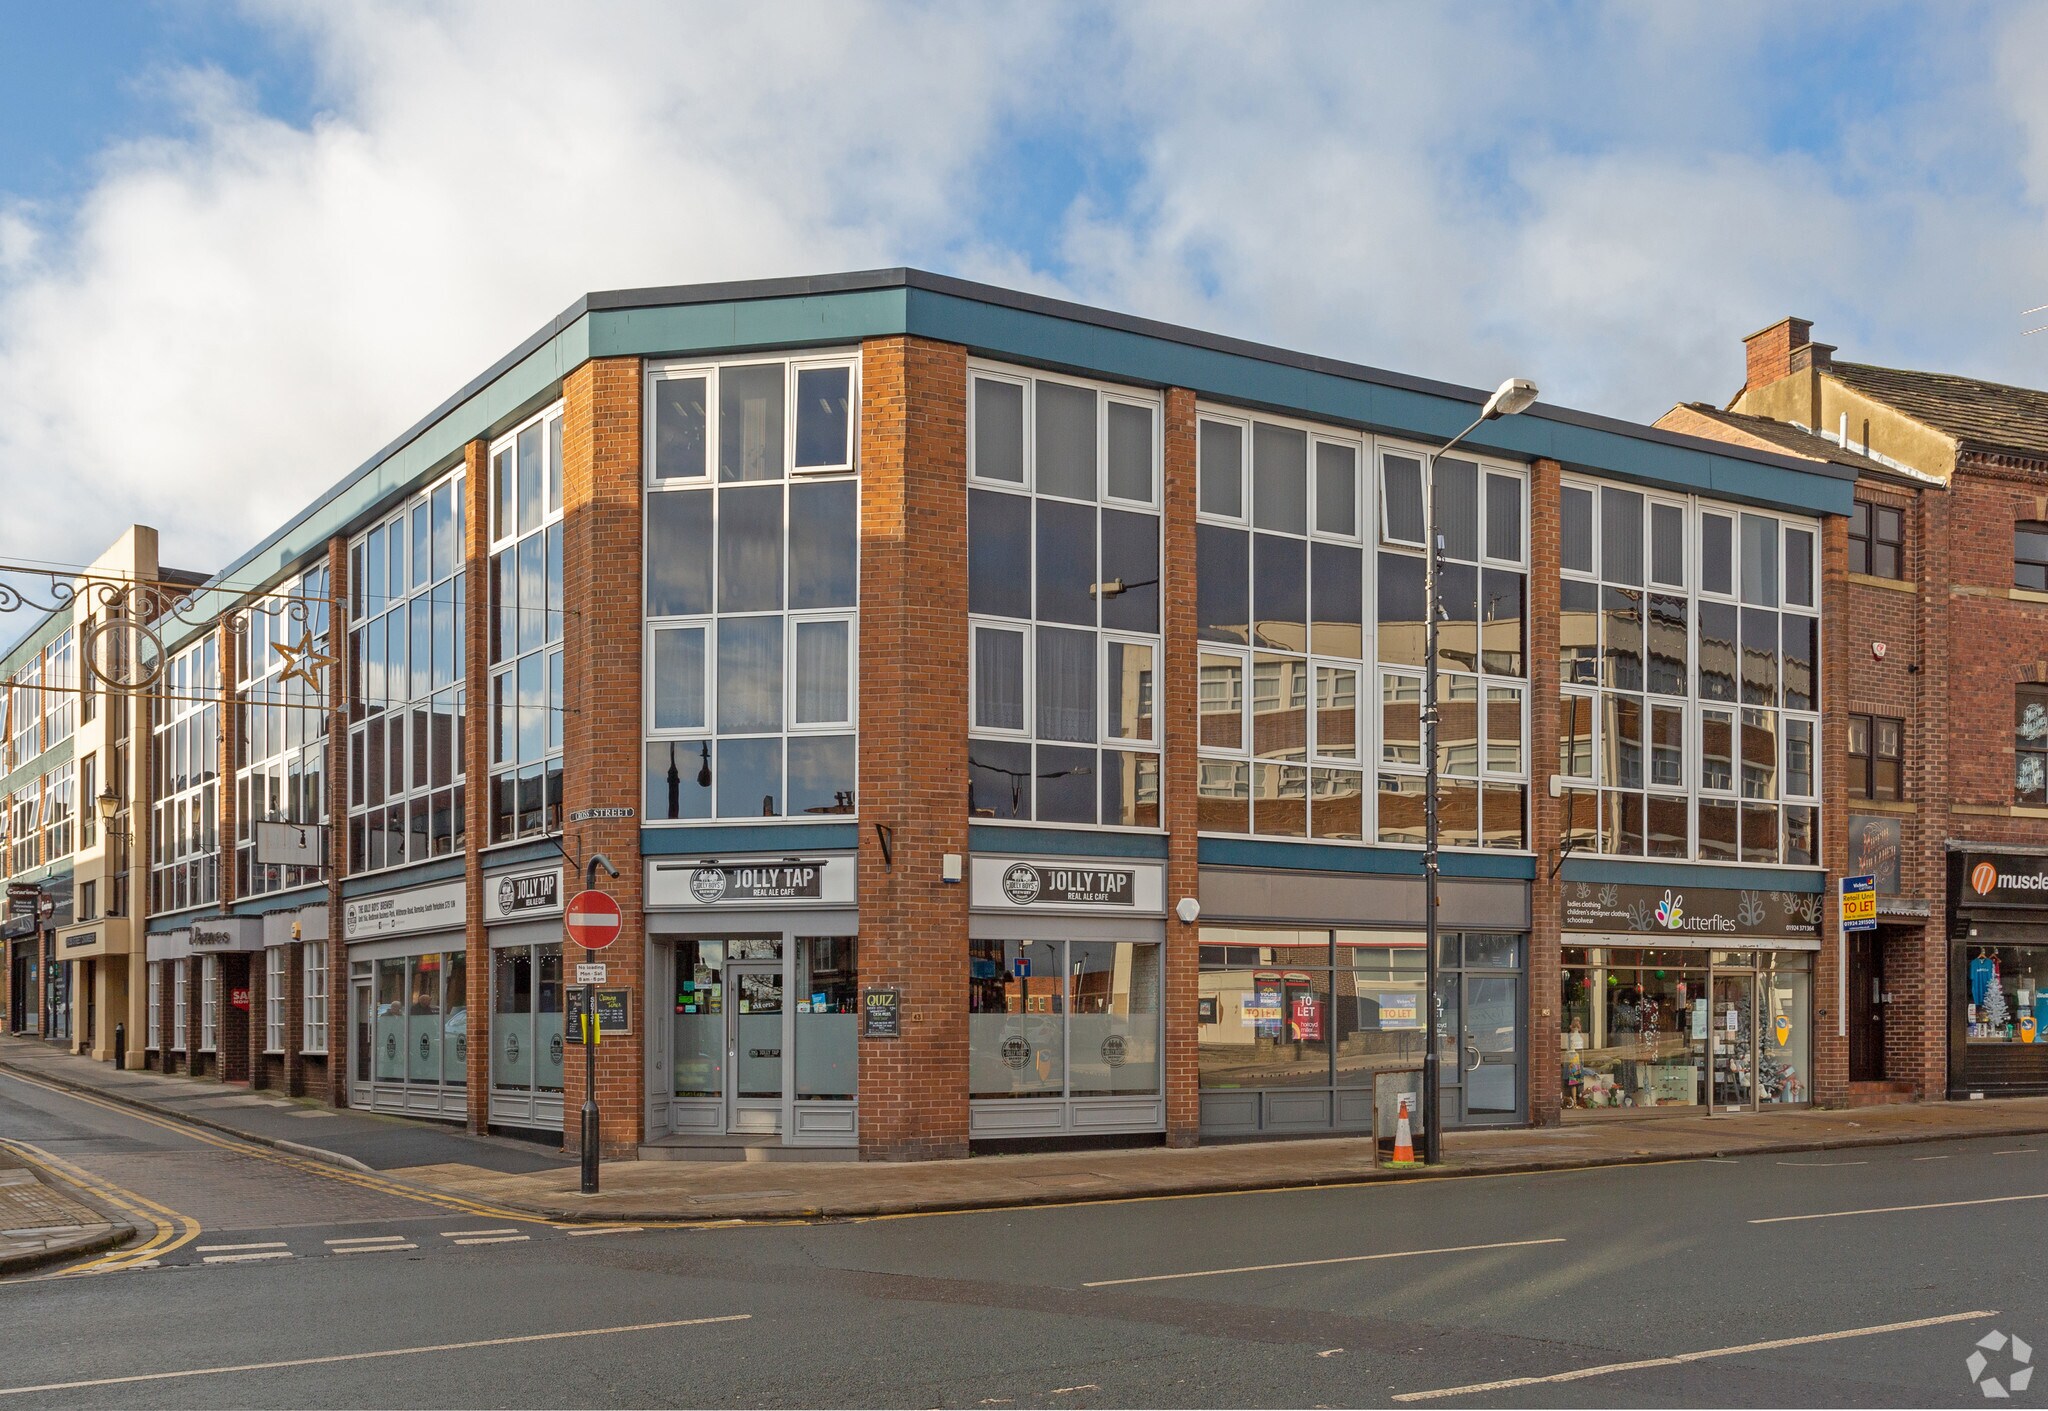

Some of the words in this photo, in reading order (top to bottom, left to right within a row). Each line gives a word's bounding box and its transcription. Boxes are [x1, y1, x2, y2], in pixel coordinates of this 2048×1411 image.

[594, 808, 629, 817] STREET
[734, 869, 780, 888] JOLLY
[780, 868, 814, 887] TAP
[1049, 871, 1094, 892] JOLLY
[1098, 872, 1126, 892] TAP
[1998, 872, 2048, 890] muscle
[517, 878, 538, 899] JOLLY
[540, 876, 554, 896] TAP
[1582, 901, 1601, 909] clothing
[1844, 902, 1856, 913] TO
[1860, 901, 1874, 911] LET
[867, 995, 895, 1006] QUIZ
[1300, 997, 1312, 1006] TO
[1247, 1009, 1259, 1017] TO
[1261, 1009, 1277, 1017] LET
[1297, 1007, 1315, 1016] LET
